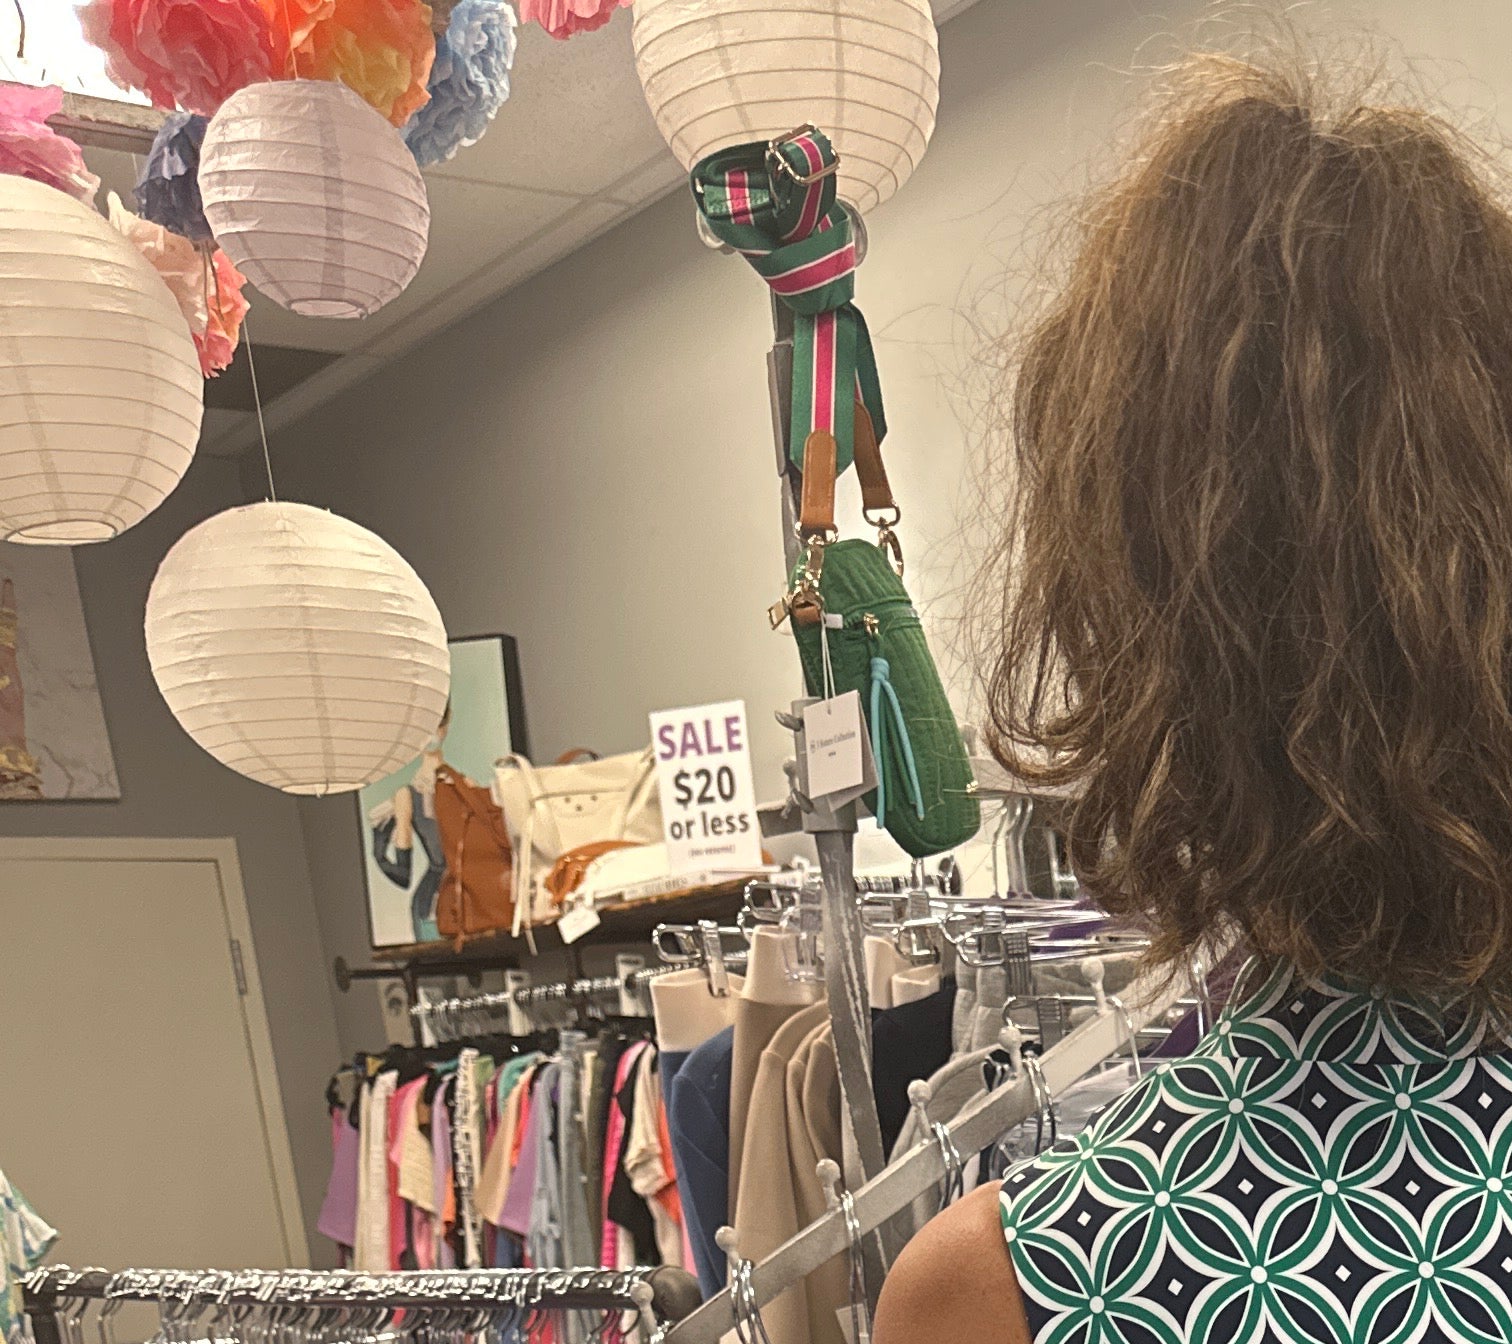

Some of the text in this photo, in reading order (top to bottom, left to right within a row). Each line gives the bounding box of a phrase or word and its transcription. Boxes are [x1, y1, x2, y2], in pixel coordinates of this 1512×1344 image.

[658, 715, 743, 761] SALE
[674, 765, 736, 811] $20
[670, 811, 750, 841] or less
